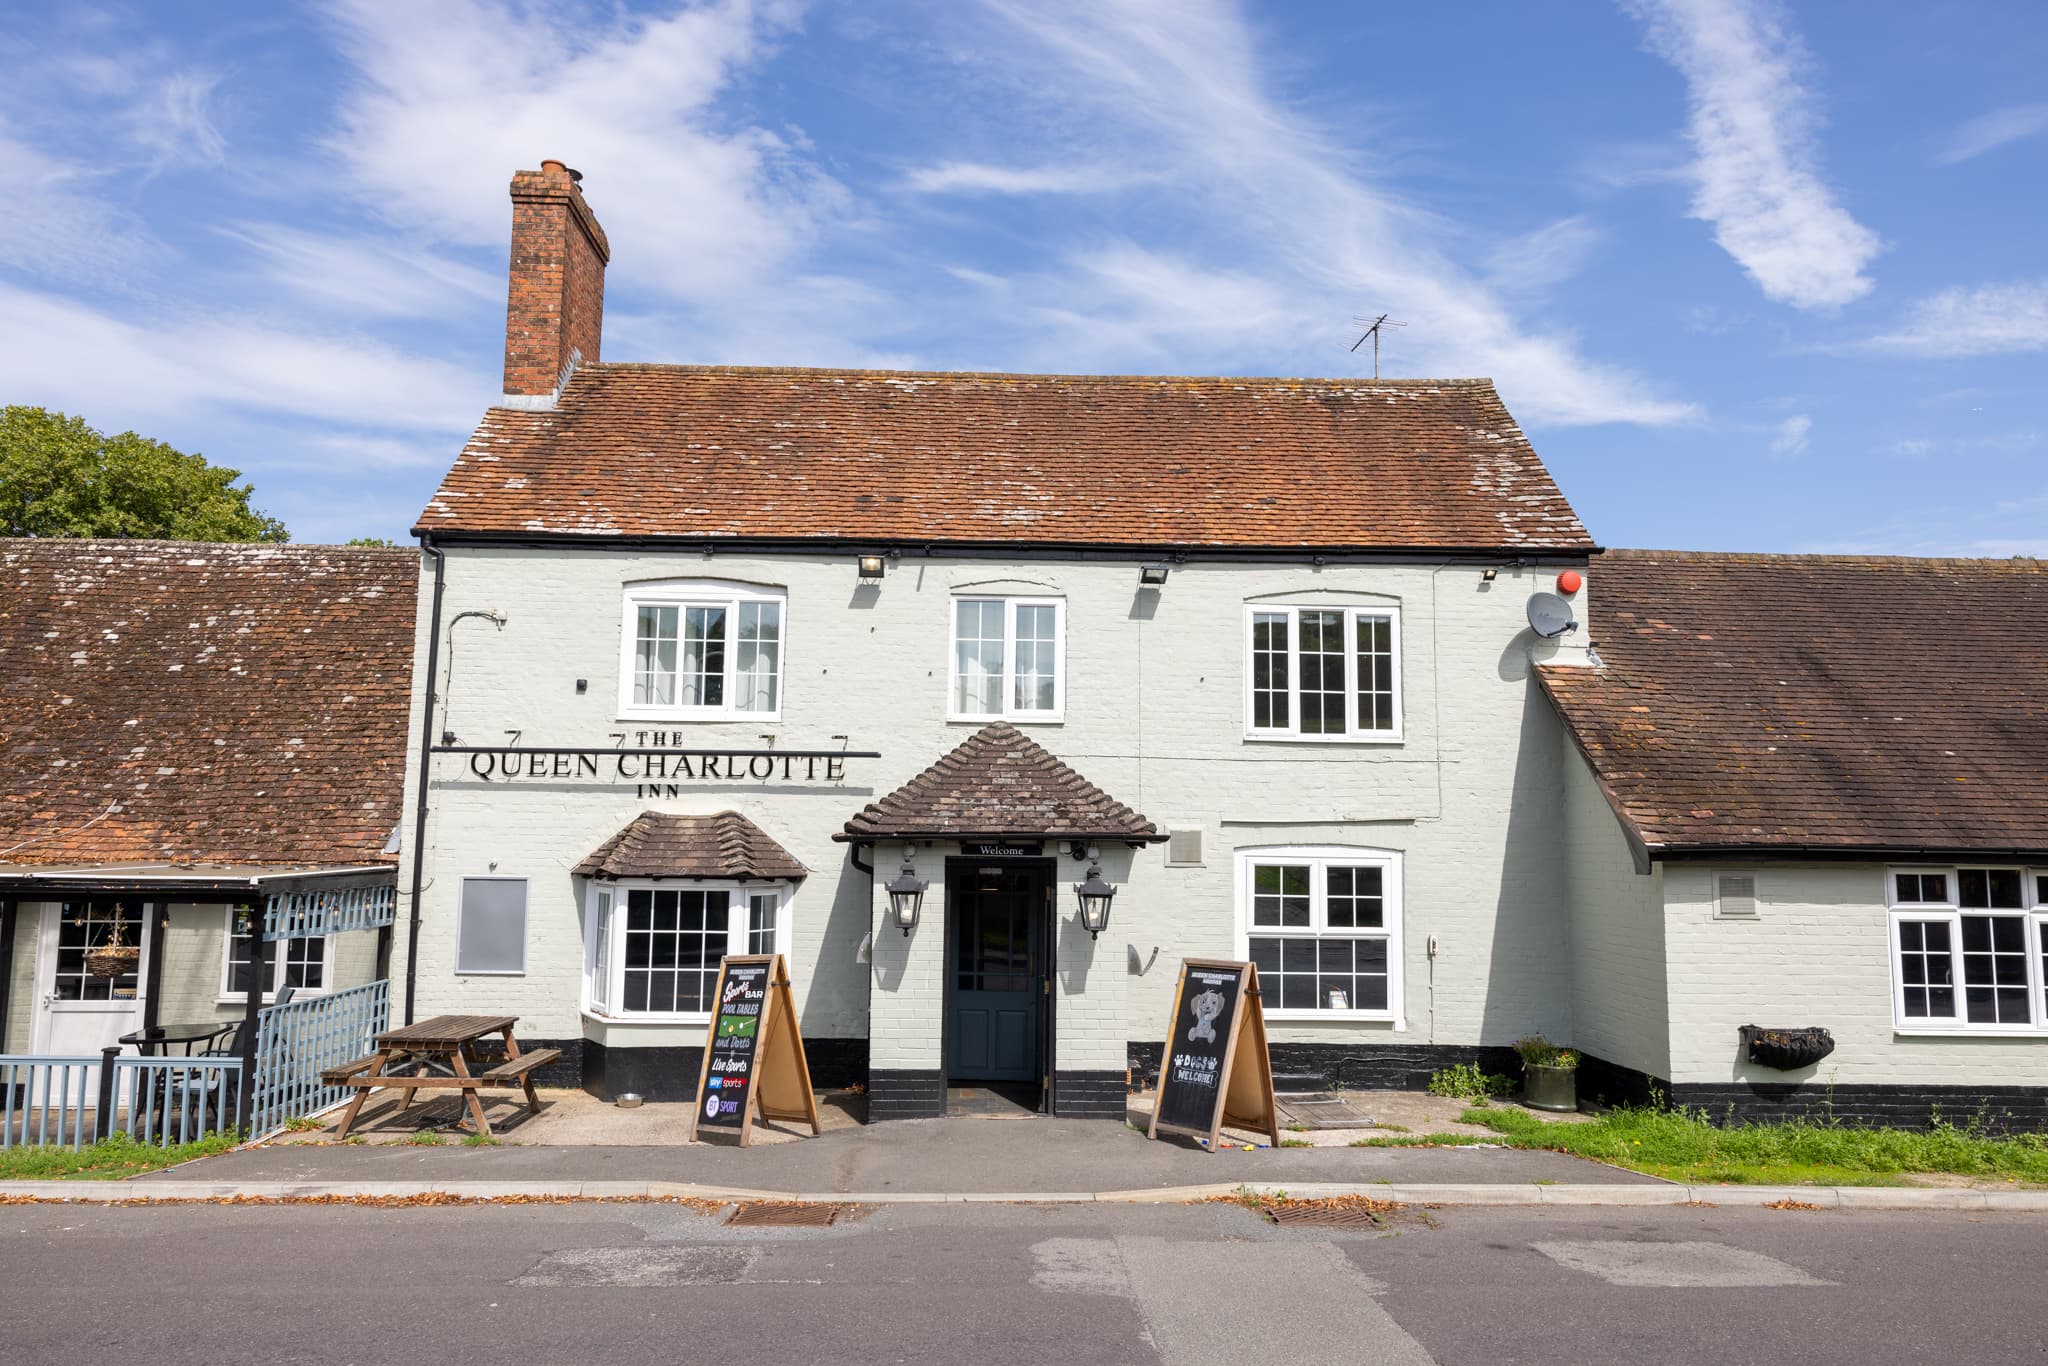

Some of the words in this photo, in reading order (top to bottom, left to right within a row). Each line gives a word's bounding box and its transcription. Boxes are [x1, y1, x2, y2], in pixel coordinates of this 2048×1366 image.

[636, 731, 683, 747] THE
[470, 752, 600, 780] QUEEN
[617, 754, 846, 781] CHARLOTTE
[636, 783, 680, 799] INN
[980, 845, 1024, 855] Welcome
[723, 980, 750, 1003] Sports
[745, 990, 764, 999] BAR
[722, 1003, 737, 1014] POOL
[737, 1004, 759, 1015] TABLES
[715, 1037, 730, 1048] and
[730, 1035, 750, 1048] Darts
[712, 1057, 726, 1071] Live
[726, 1058, 747, 1072] Sports
[709, 1079, 720, 1087] sky
[722, 1078, 743, 1088] sports
[708, 1100, 718, 1111] BT
[720, 1100, 739, 1113] SPORT
